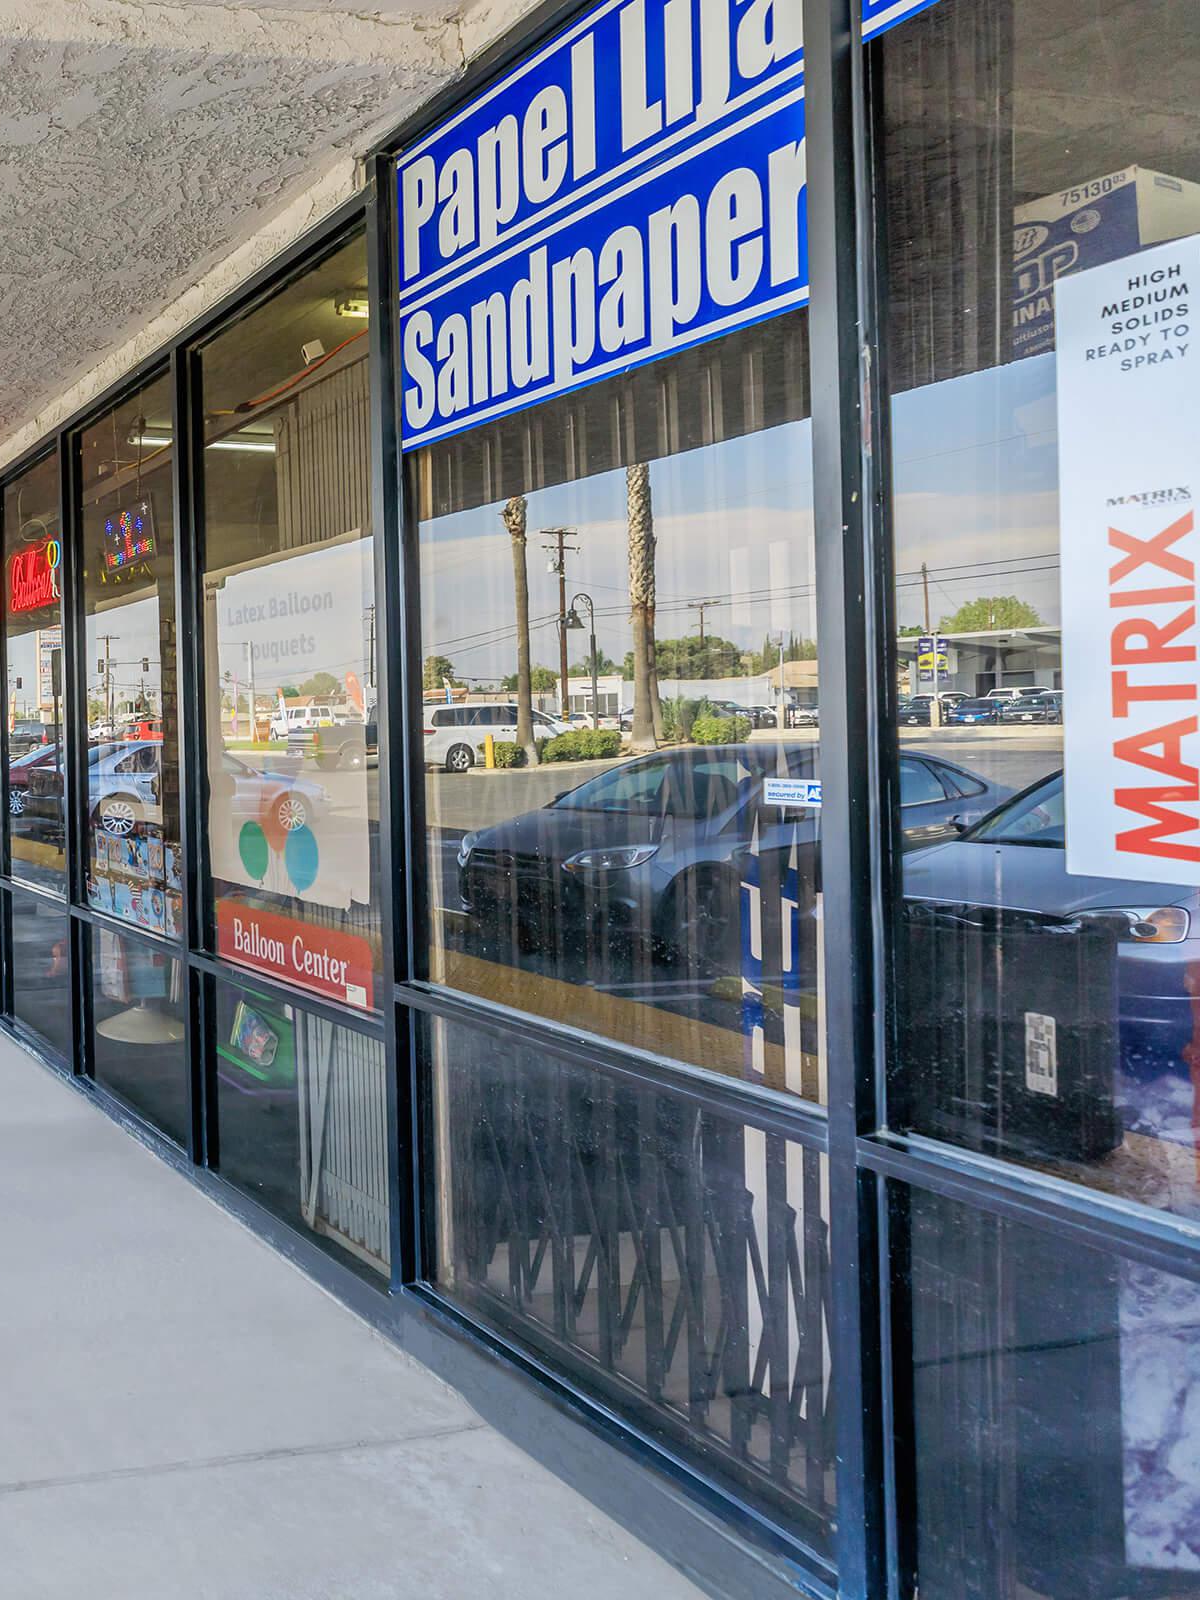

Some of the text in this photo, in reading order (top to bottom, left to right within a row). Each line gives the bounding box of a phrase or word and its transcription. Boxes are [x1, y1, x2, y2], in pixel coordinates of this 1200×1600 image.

[402, 0, 804, 282] Papel Lija
[404, 136, 806, 430] Sandpaper
[1128, 264, 1181, 291] HIGH
[1101, 283, 1189, 319] MEDIUM
[1111, 304, 1189, 335] SOLIDS
[1086, 324, 1190, 361] READY TO
[1120, 343, 1190, 372] SPRAY
[1105, 485, 1192, 507] MATRIX
[228, 591, 333, 626] Latex Balloon
[1108, 509, 1200, 862] MATRIX
[233, 917, 348, 986] Balloon Center
